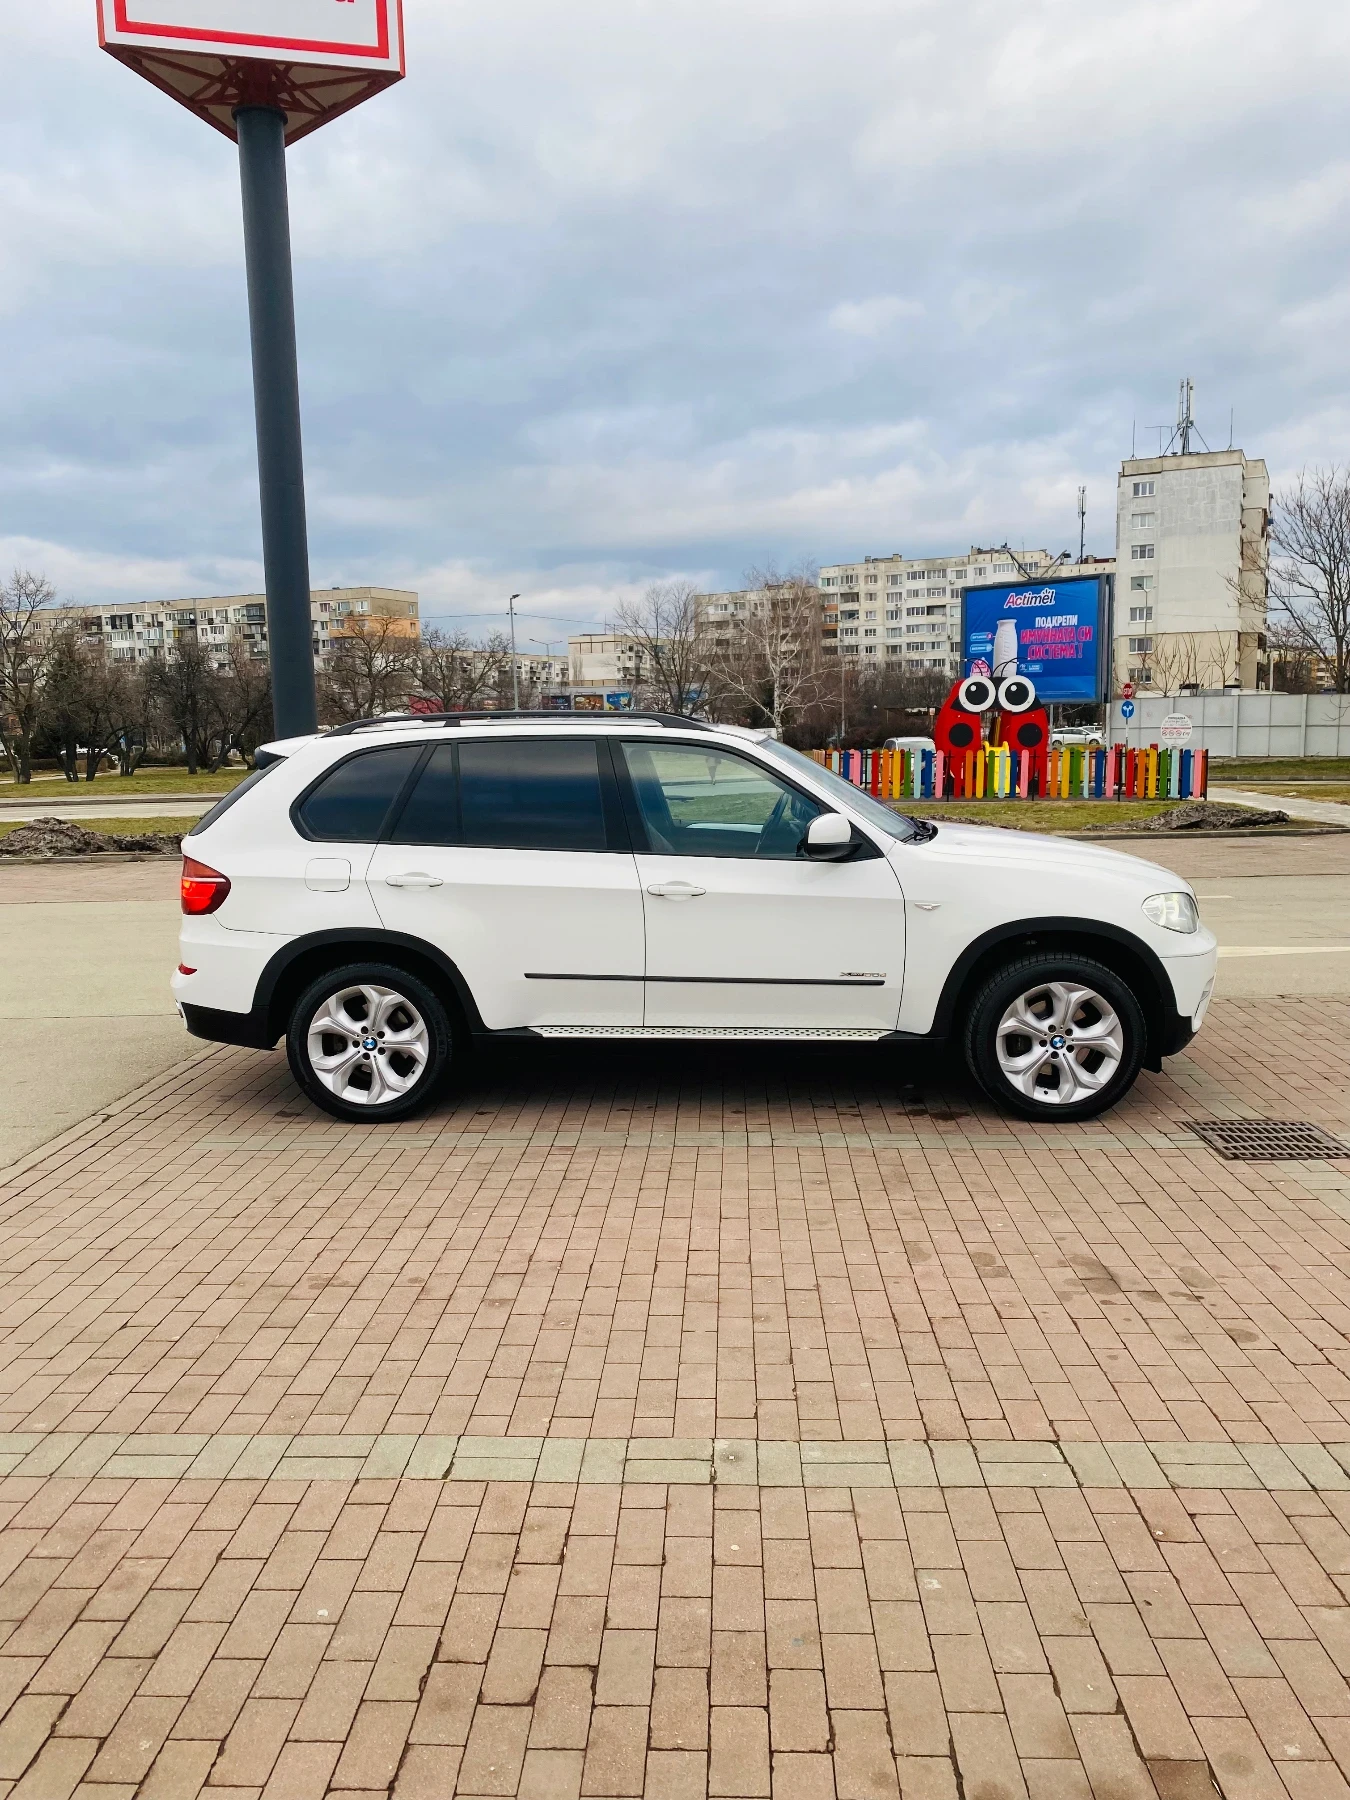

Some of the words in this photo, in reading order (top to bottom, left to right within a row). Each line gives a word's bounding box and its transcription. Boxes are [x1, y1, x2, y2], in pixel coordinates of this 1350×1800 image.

[1004, 588, 1055, 608] Actimel
[1035, 615, 1078, 628] ПОДКРЕПИ
[1021, 627, 1075, 644] ИМУННАТА
[1077, 626, 1093, 642] СИ
